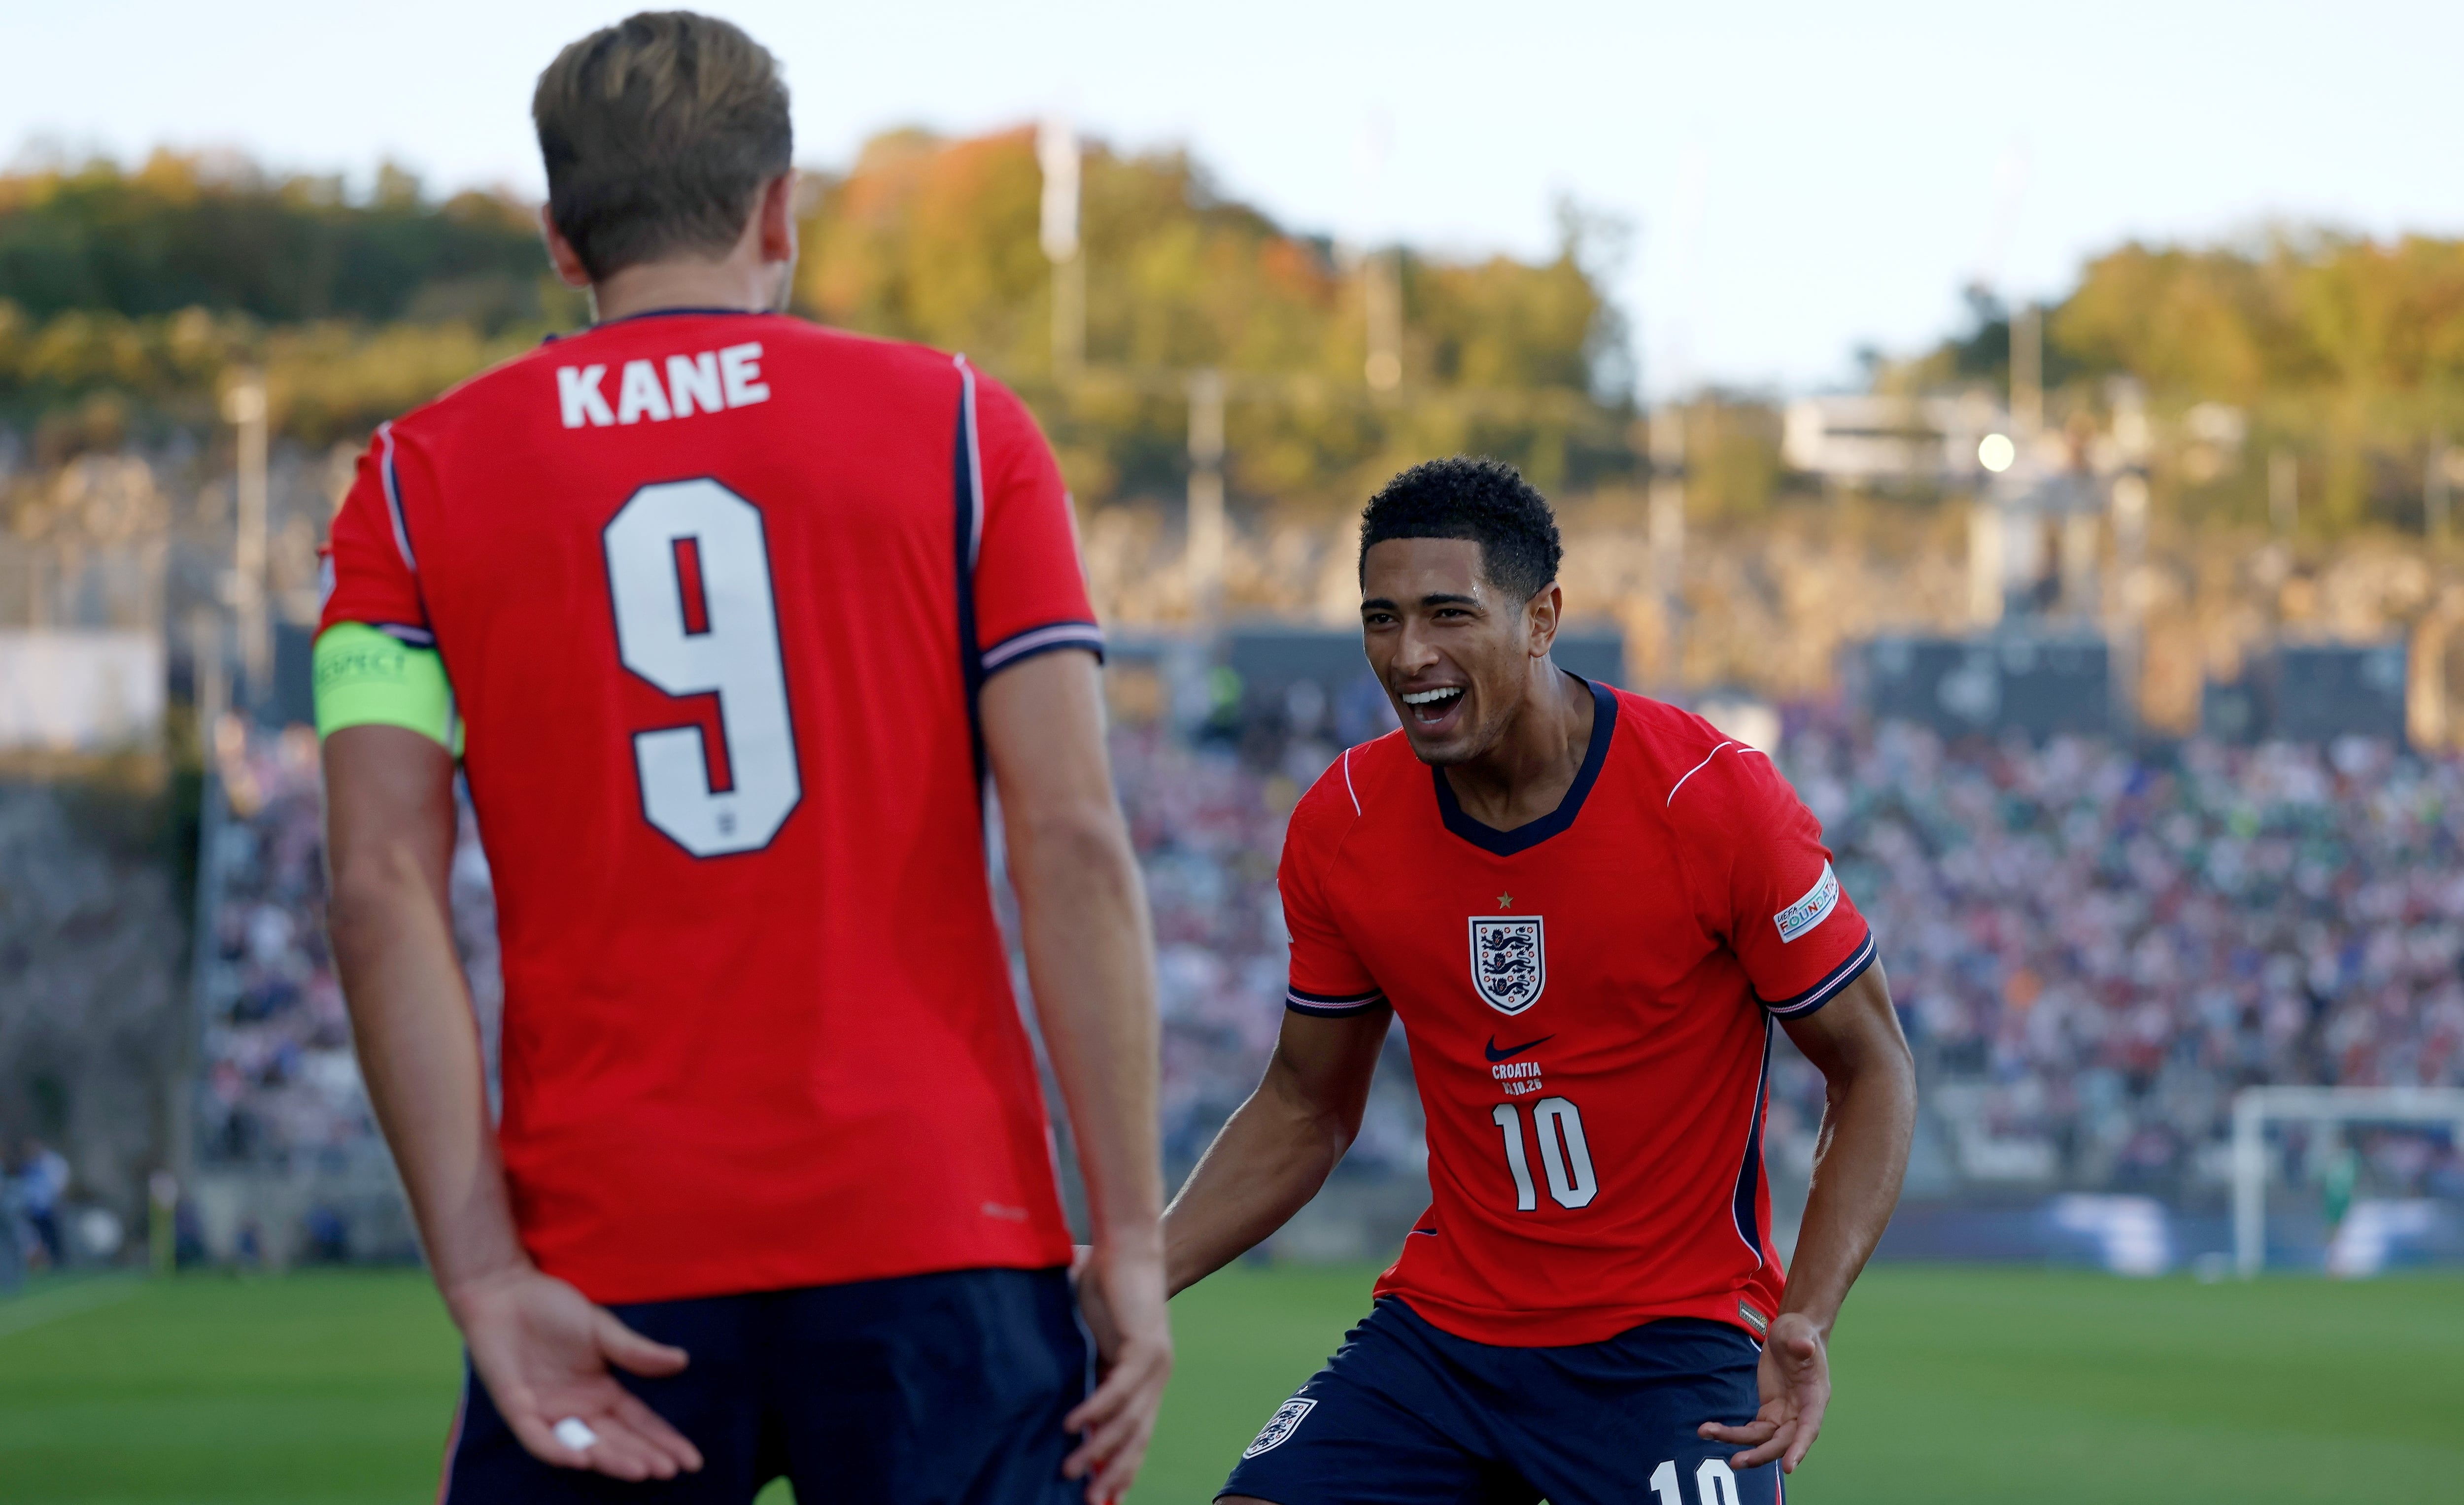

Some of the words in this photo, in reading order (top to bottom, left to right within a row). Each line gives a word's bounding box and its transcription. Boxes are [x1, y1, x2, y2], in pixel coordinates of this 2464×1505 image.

[557, 342, 770, 429] KANE
[602, 475, 803, 859] 9
[1778, 906, 1799, 923] UEFA
[1492, 1061, 1542, 1079] CROATIA
[1491, 1095, 1599, 1212] 10
